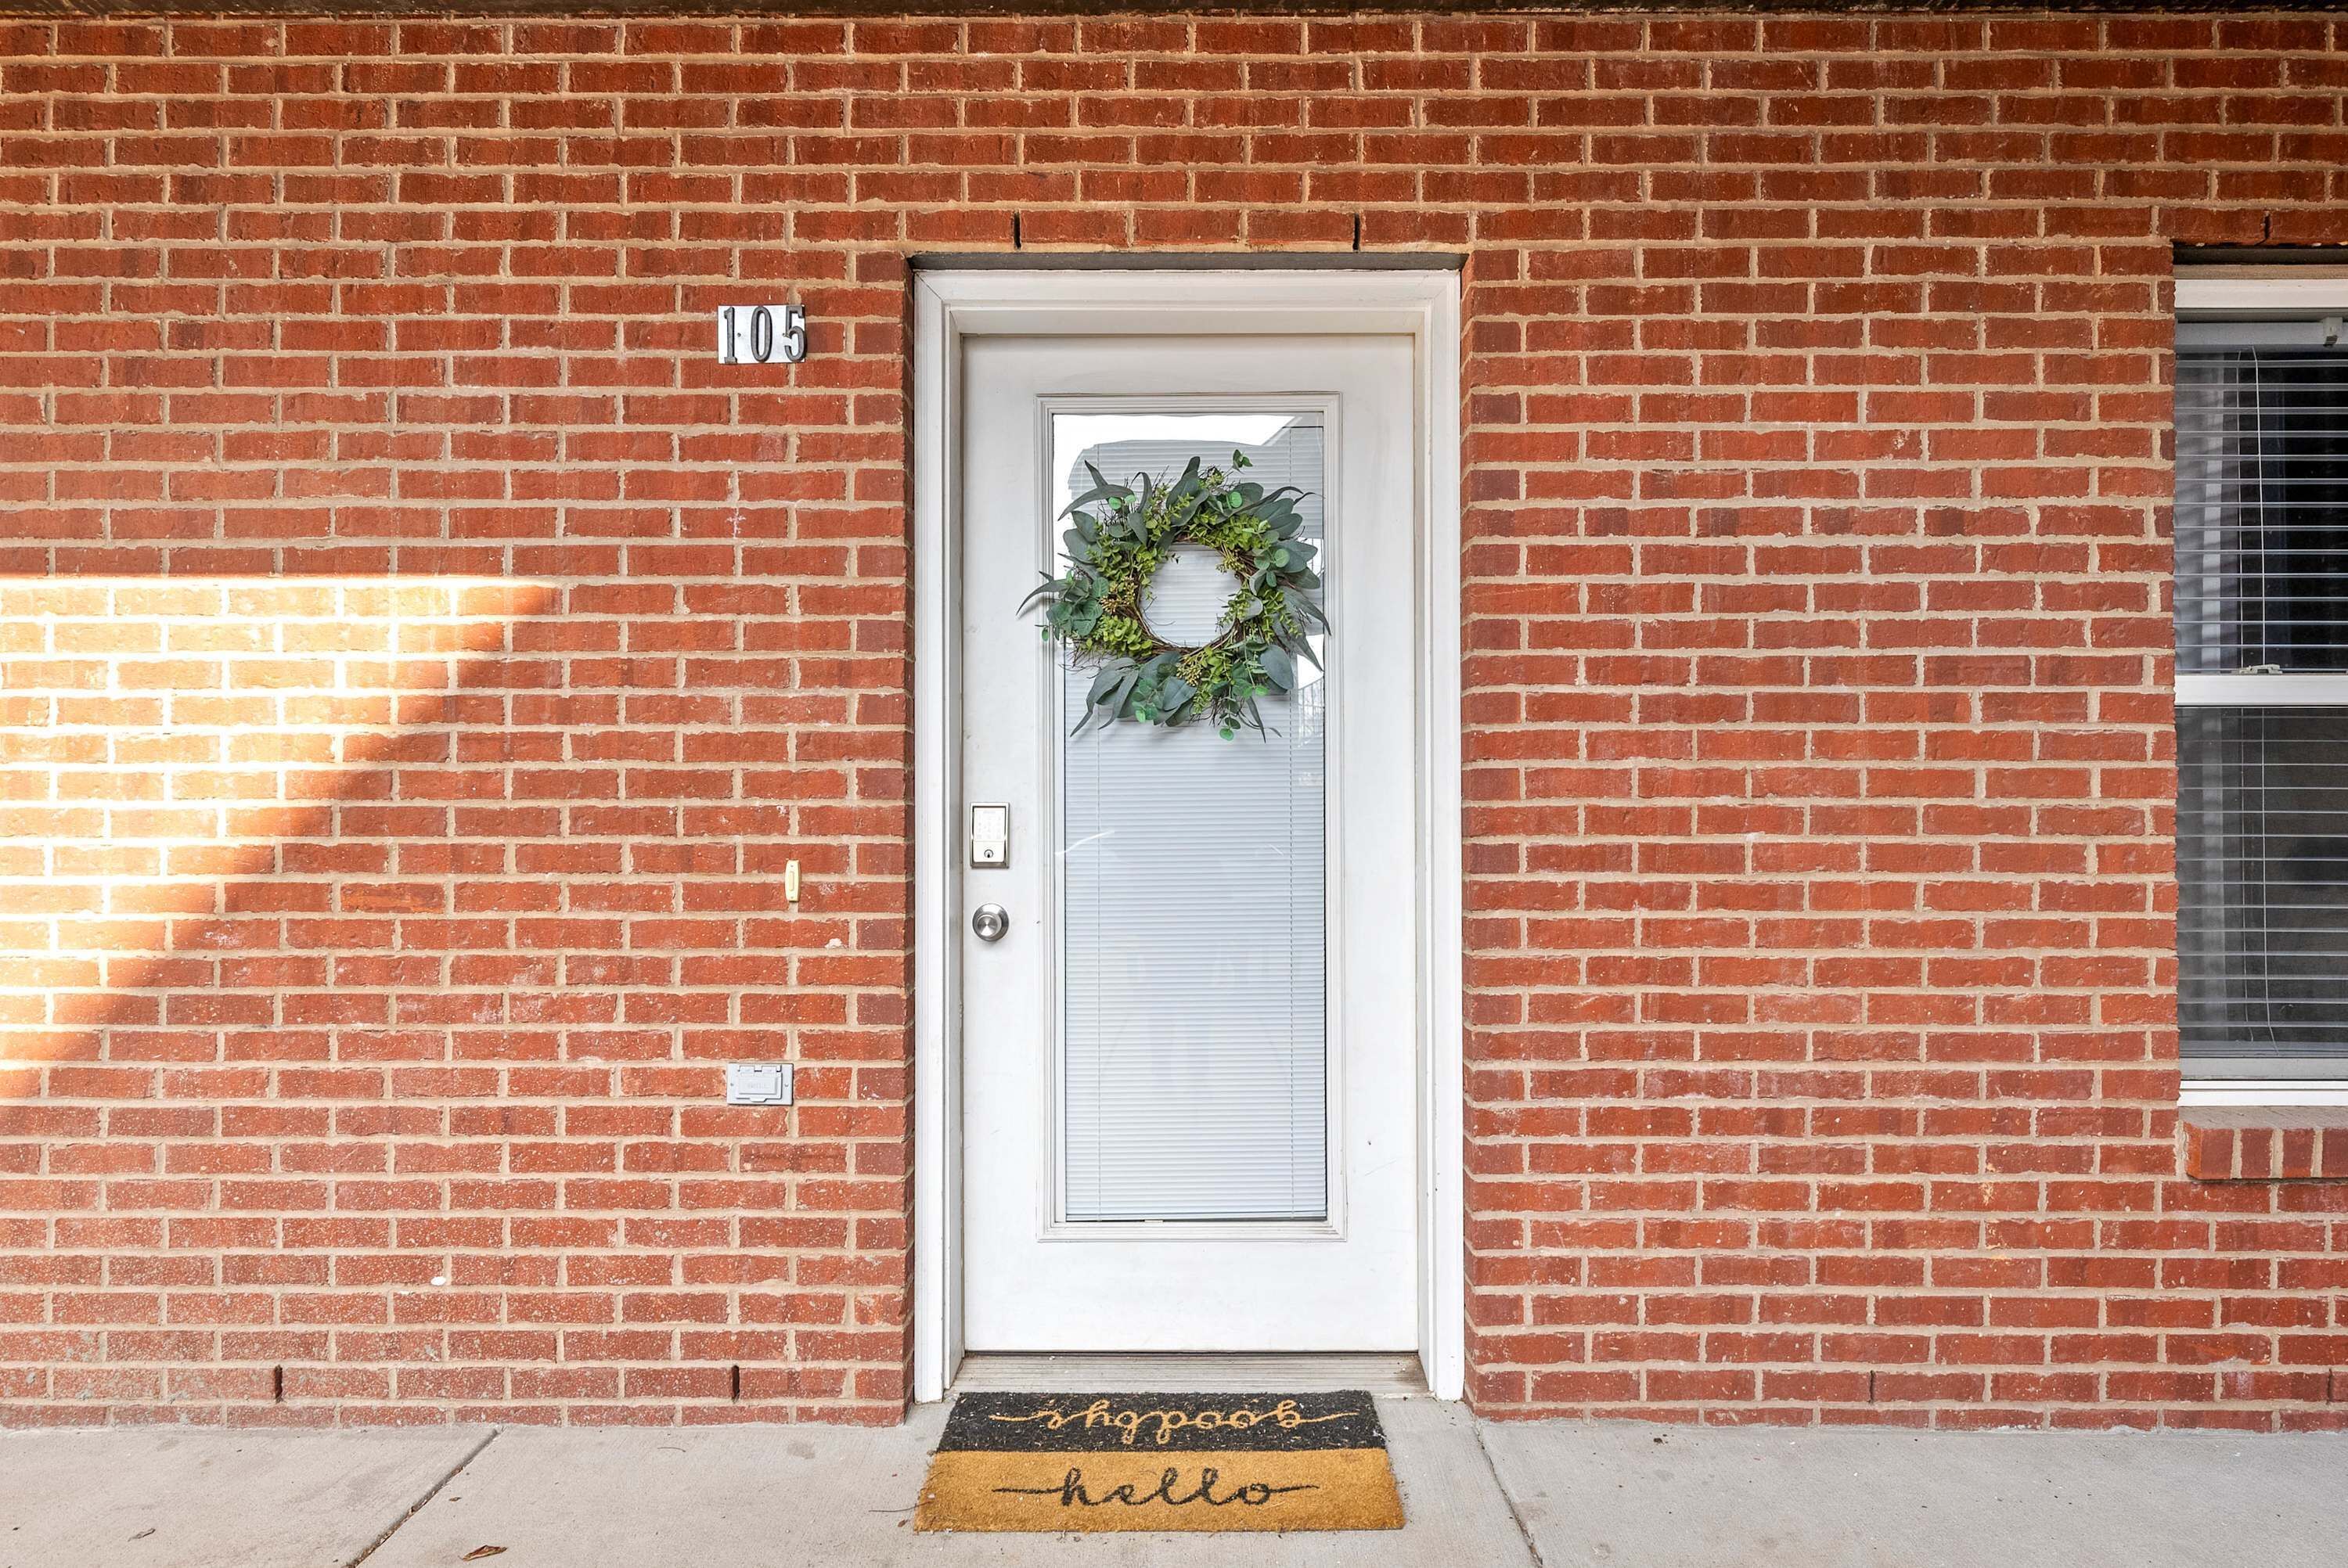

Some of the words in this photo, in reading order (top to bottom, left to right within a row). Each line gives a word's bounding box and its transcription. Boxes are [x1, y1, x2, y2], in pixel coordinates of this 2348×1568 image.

[723, 306, 807, 364] 105
[989, 1398, 1359, 1445] goodbye
[991, 1466, 1320, 1507] hello
